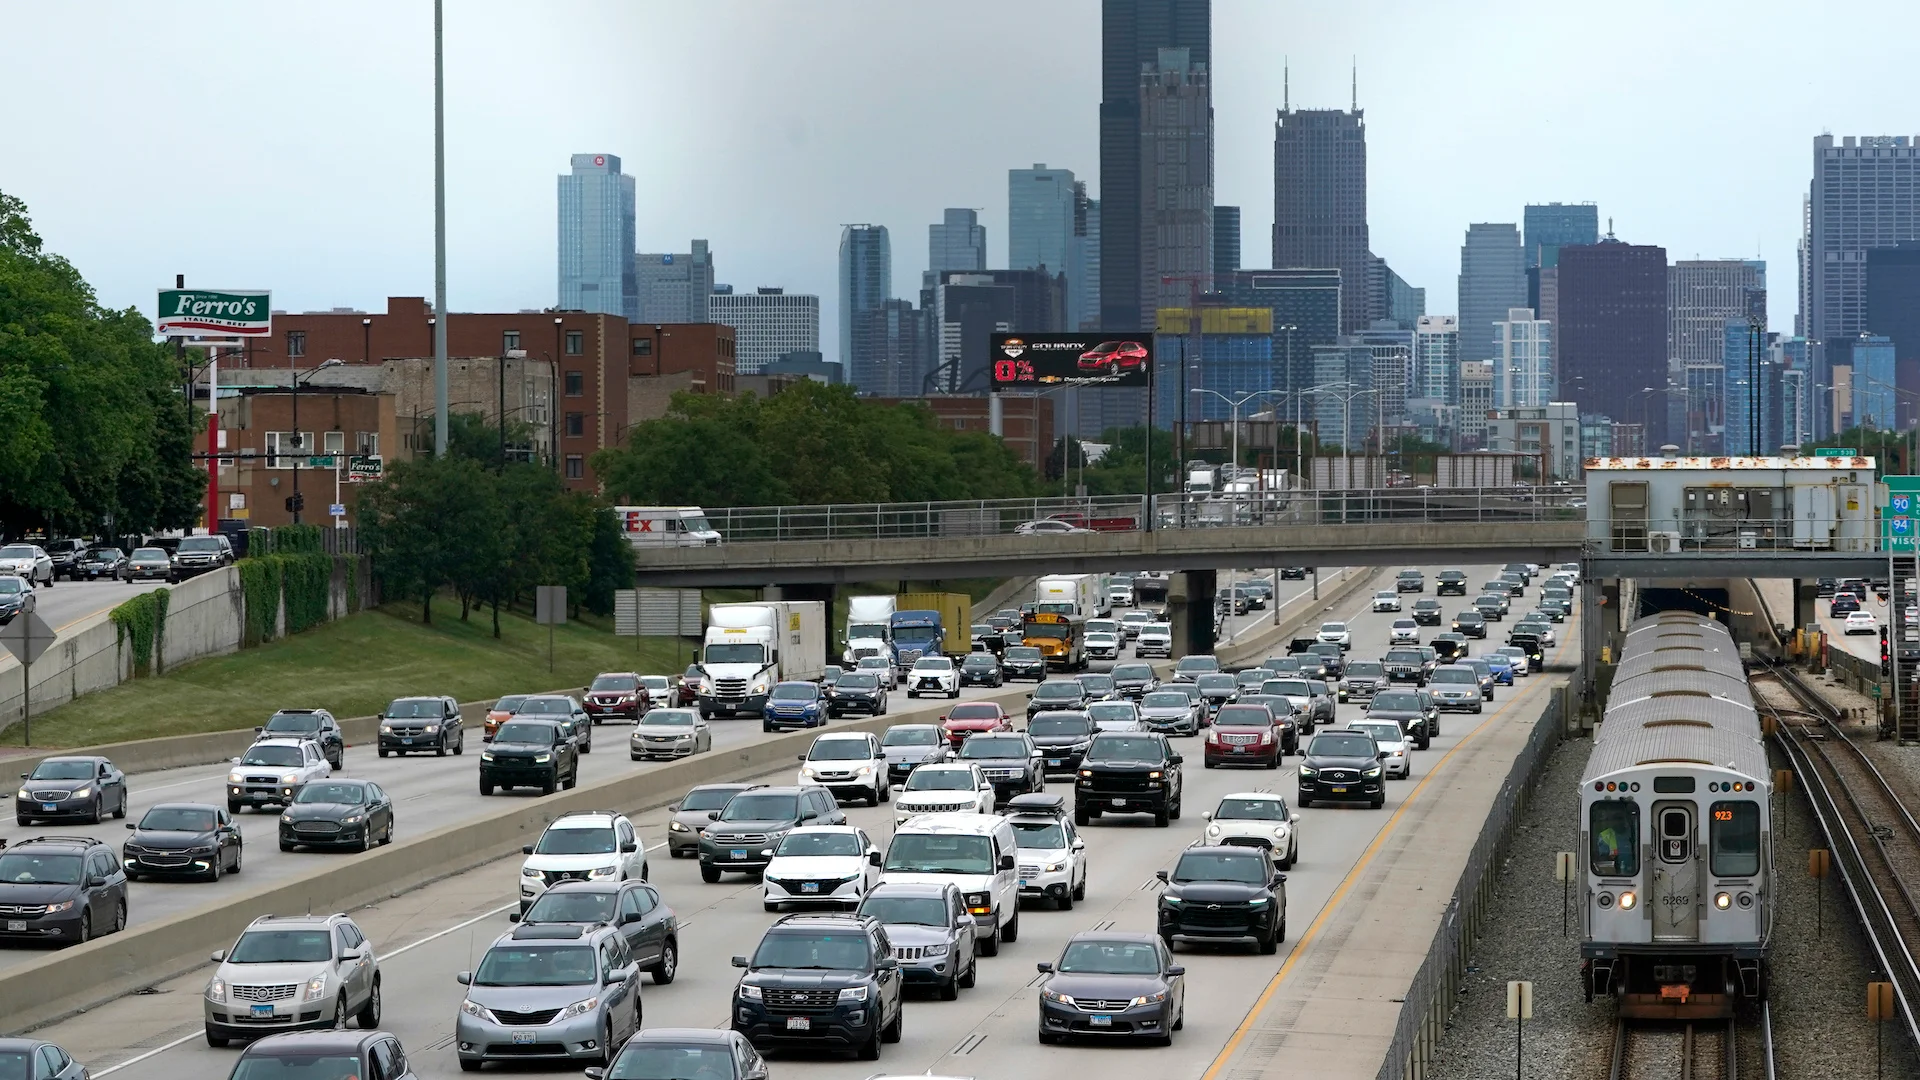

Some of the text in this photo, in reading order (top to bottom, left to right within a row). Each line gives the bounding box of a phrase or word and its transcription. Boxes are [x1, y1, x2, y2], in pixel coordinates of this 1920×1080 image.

[174, 295, 257, 315] Ferro's
[184, 316, 222, 325] ITALIAN
[1031, 342, 1086, 351] EQUINOX
[351, 462, 381, 471] Ferro's
[1893, 498, 1909, 510] 90
[626, 511, 652, 532] Ex
[1893, 519, 1909, 530] 94
[1892, 537, 1920, 545] WISC
[1715, 811, 1732, 820] 923
[1662, 895, 1689, 905] 5269
